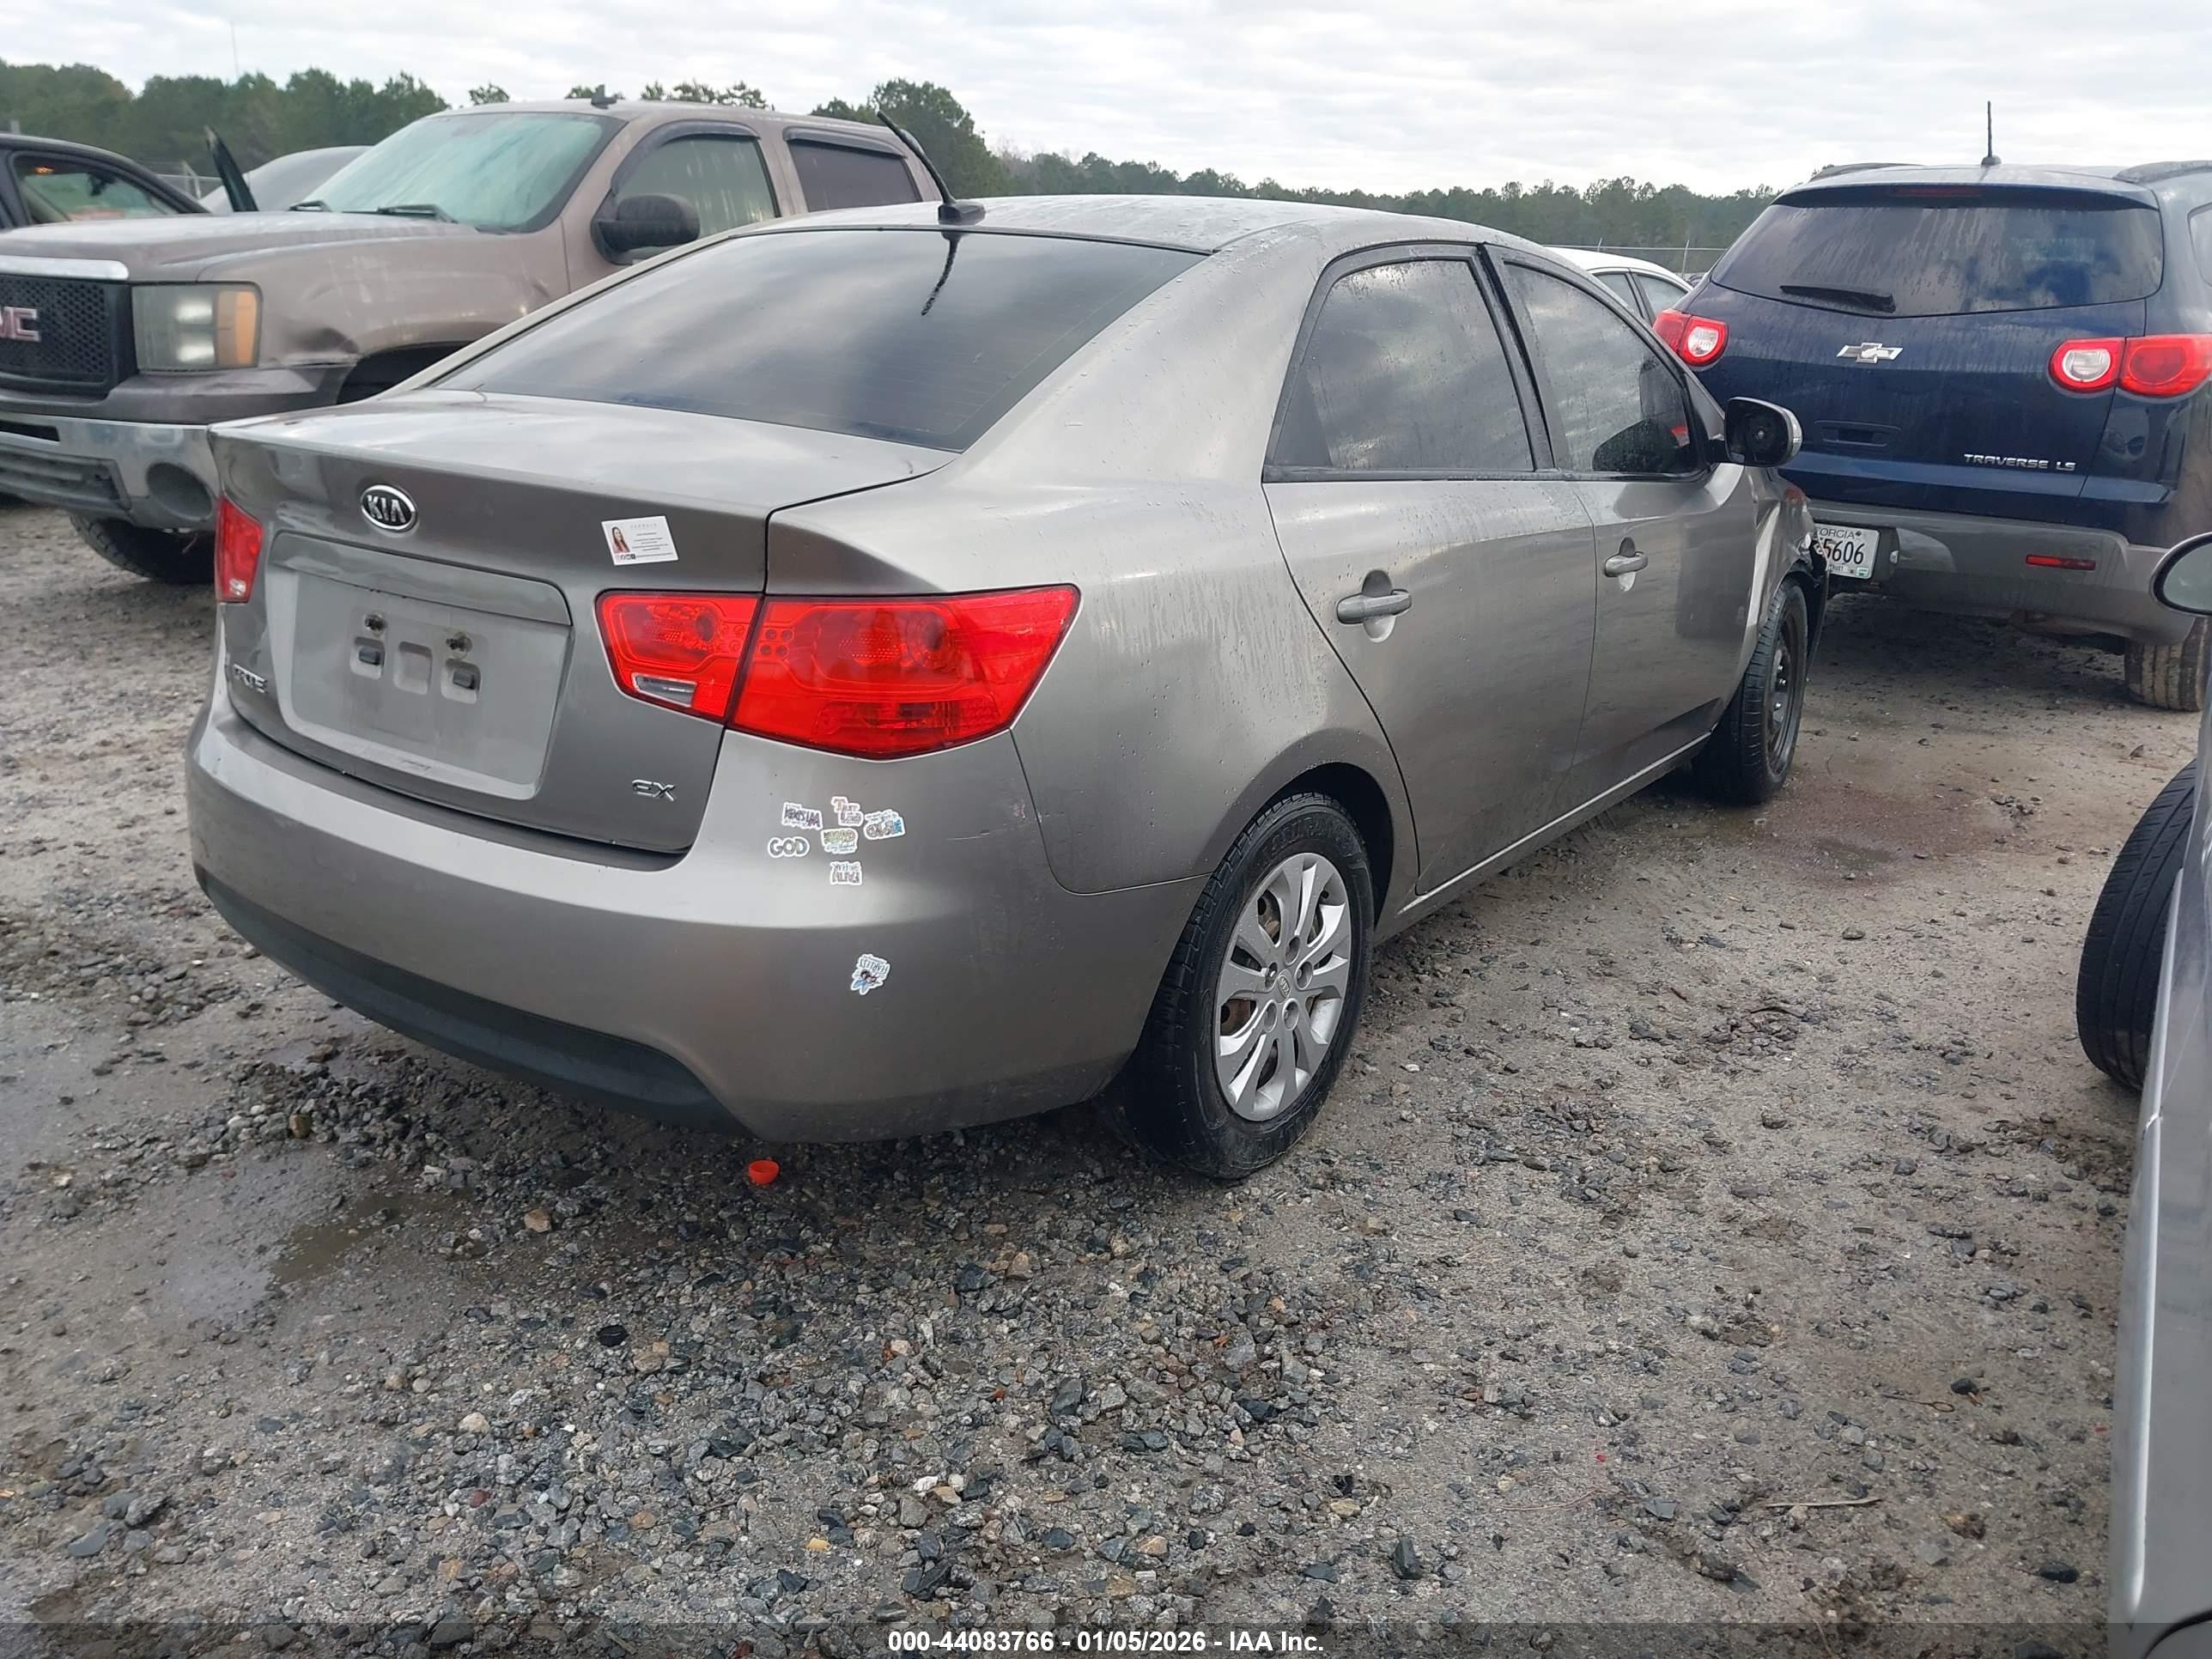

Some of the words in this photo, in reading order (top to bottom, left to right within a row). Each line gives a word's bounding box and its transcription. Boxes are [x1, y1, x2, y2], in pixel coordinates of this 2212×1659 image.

[1964, 453, 2050, 470] TRAVERSE
[2056, 461, 2077, 471] LS
[367, 494, 407, 524] KIA
[1819, 527, 1855, 539] ORGIA
[631, 779, 675, 802] EX
[769, 838, 808, 856] GOD
